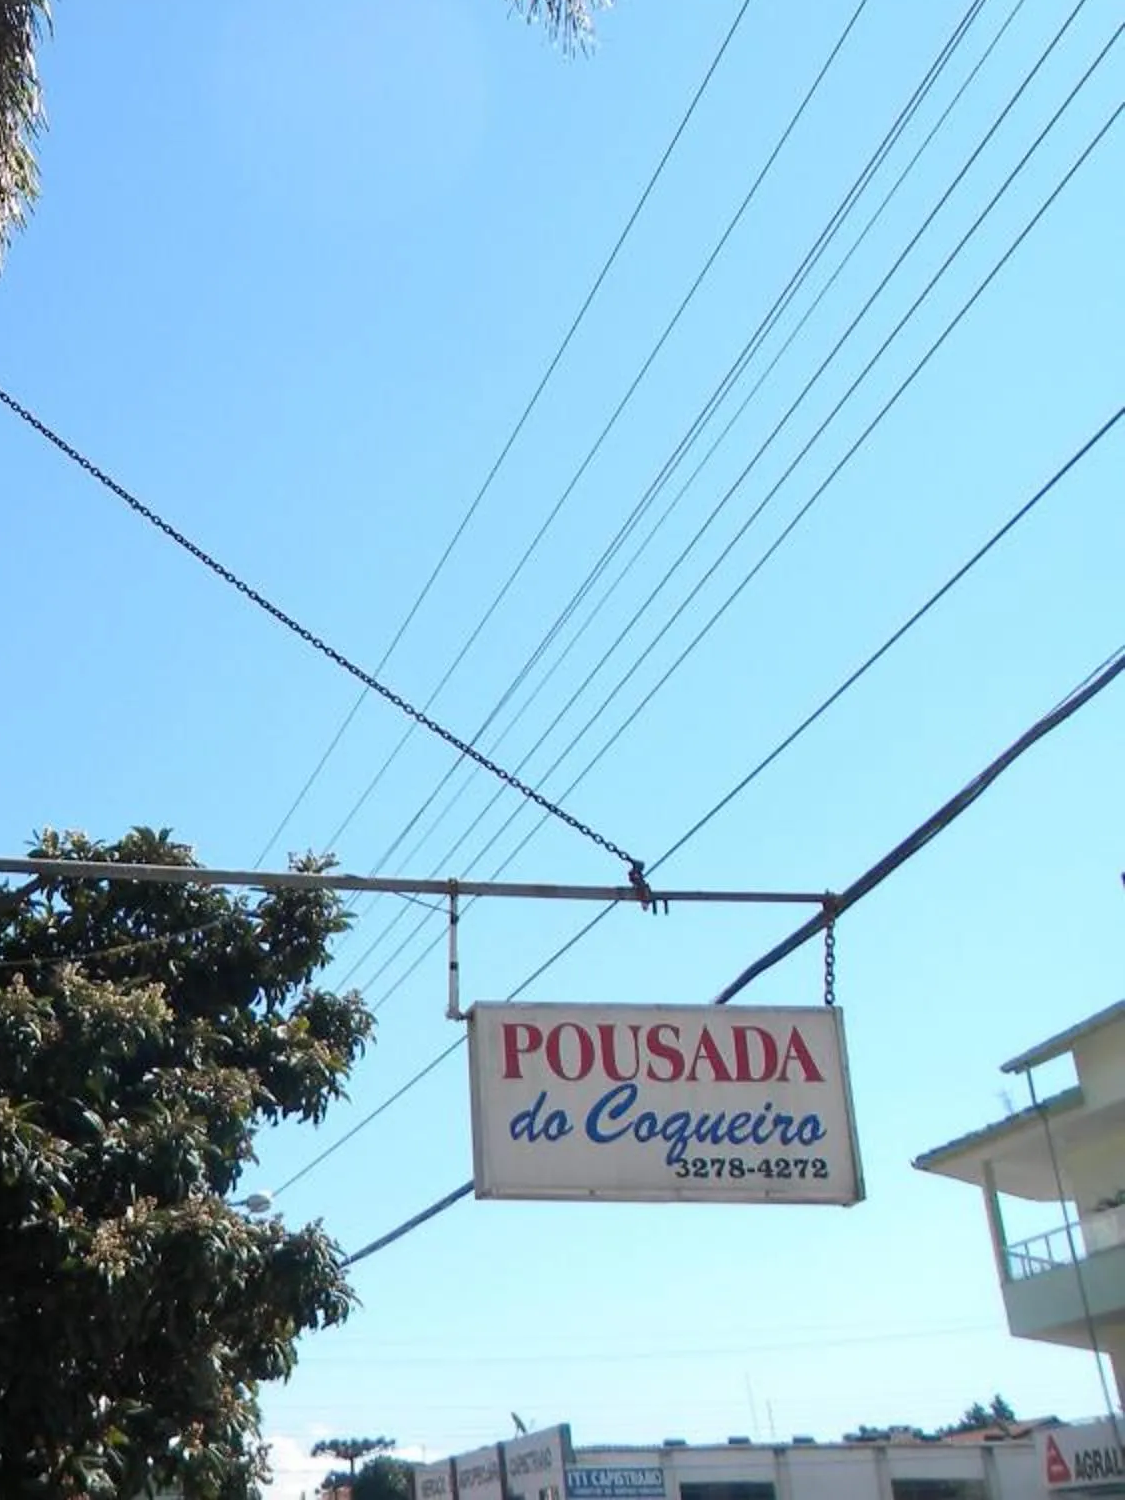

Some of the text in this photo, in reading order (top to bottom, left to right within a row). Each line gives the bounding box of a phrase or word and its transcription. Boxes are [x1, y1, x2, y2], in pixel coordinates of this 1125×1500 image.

[502, 1022, 825, 1082] POUSADA
[509, 1083, 827, 1165] do Coqueiro
[675, 1157, 829, 1179] 3278-4272
[1074, 1445, 1125, 1481] AGRAL
